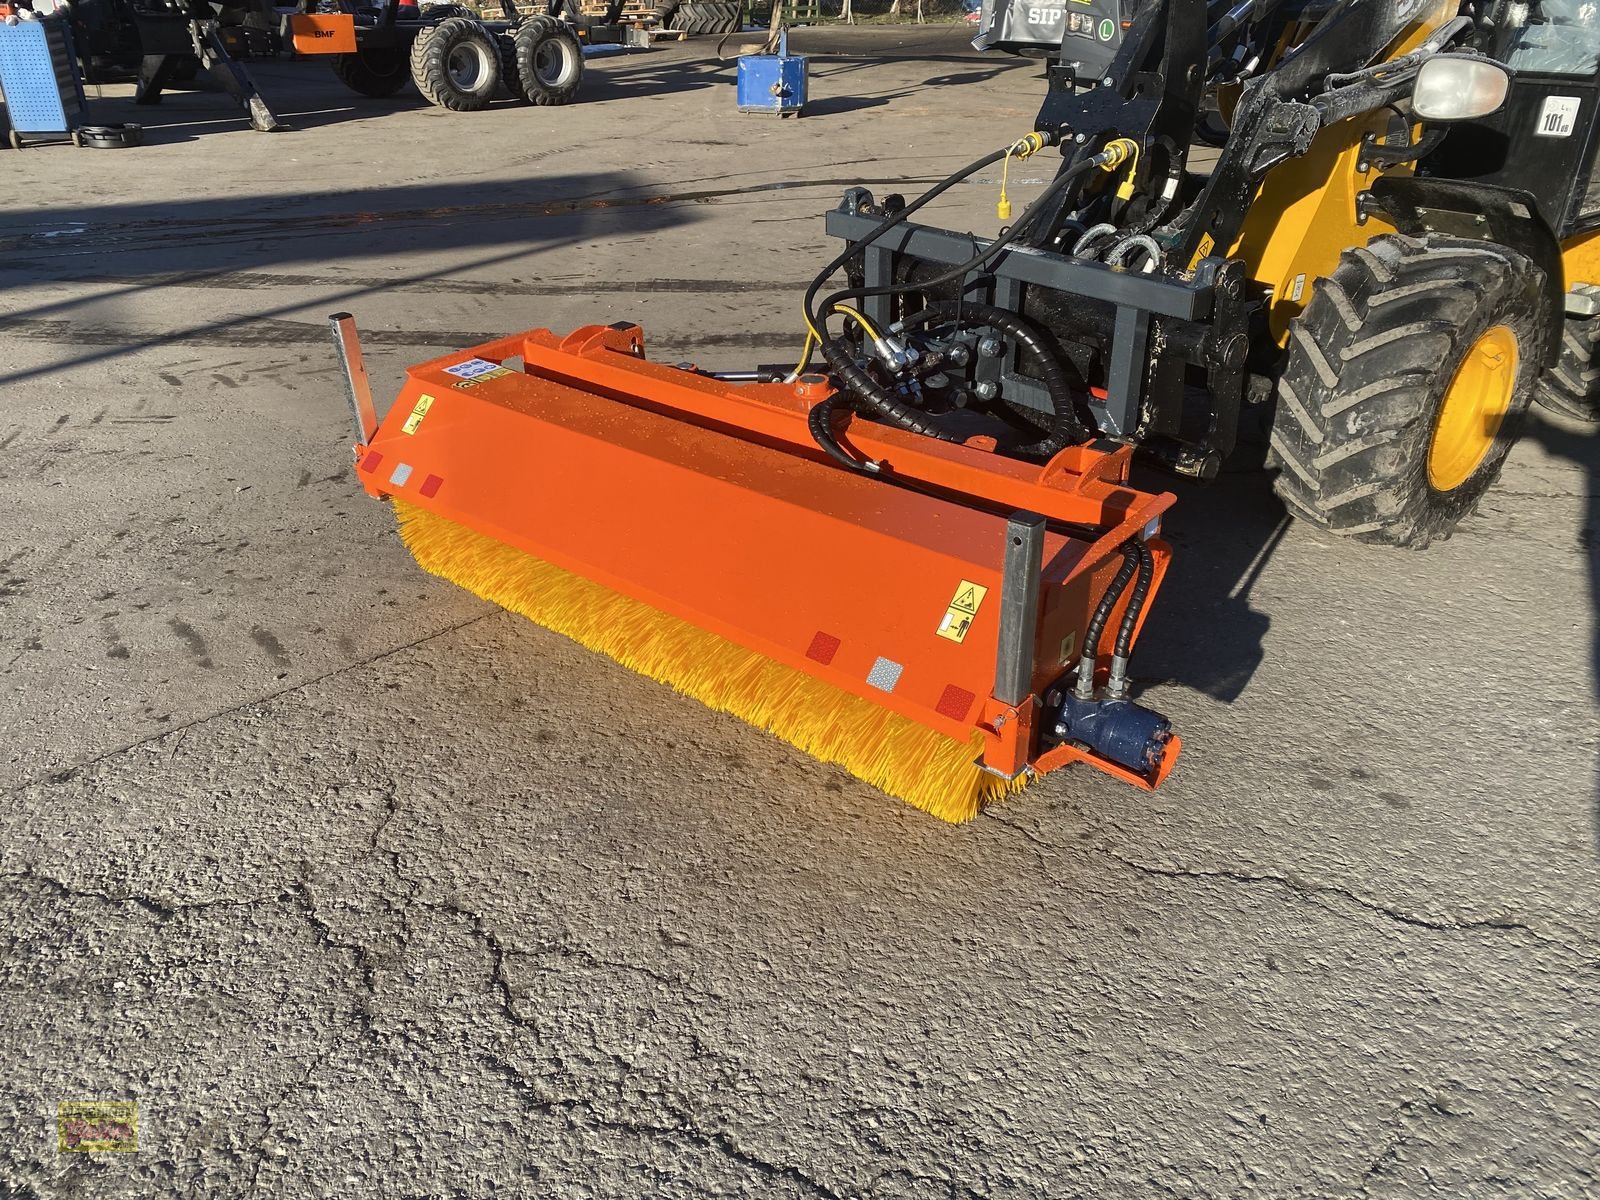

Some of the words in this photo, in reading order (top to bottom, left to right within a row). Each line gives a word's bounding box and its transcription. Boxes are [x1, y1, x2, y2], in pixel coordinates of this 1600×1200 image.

[1028, 8, 1061, 25] SIP
[314, 30, 336, 39] BMF
[1544, 113, 1564, 132] 101
